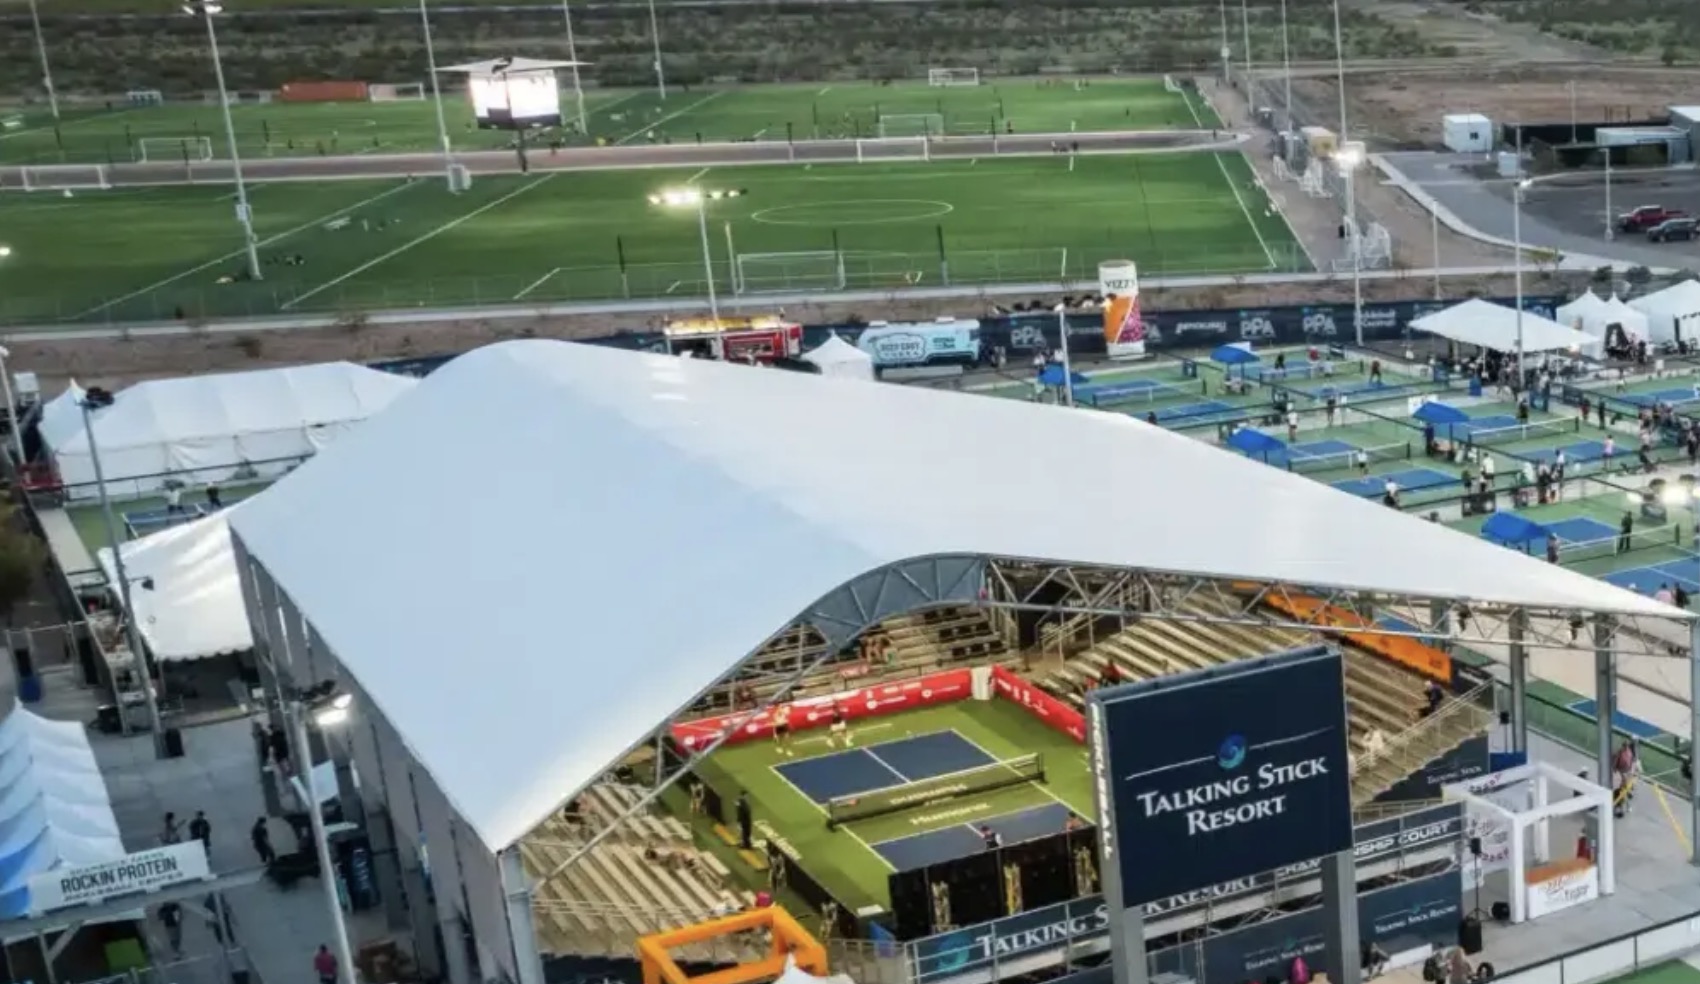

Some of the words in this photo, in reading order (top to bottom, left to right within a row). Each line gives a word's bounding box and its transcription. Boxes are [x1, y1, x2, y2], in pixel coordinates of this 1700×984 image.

[1010, 326, 1047, 349] PPA
[1240, 317, 1275, 338] PPA
[1303, 313, 1338, 335] PPA
[1136, 775, 1250, 818] TALKING
[1257, 756, 1330, 790] STICK
[1186, 795, 1288, 836] RESORT
[1398, 821, 1450, 843] COURT
[61, 869, 115, 894] ROCKIN
[117, 856, 178, 879] PROTEIN
[975, 917, 1089, 958] TALKING
